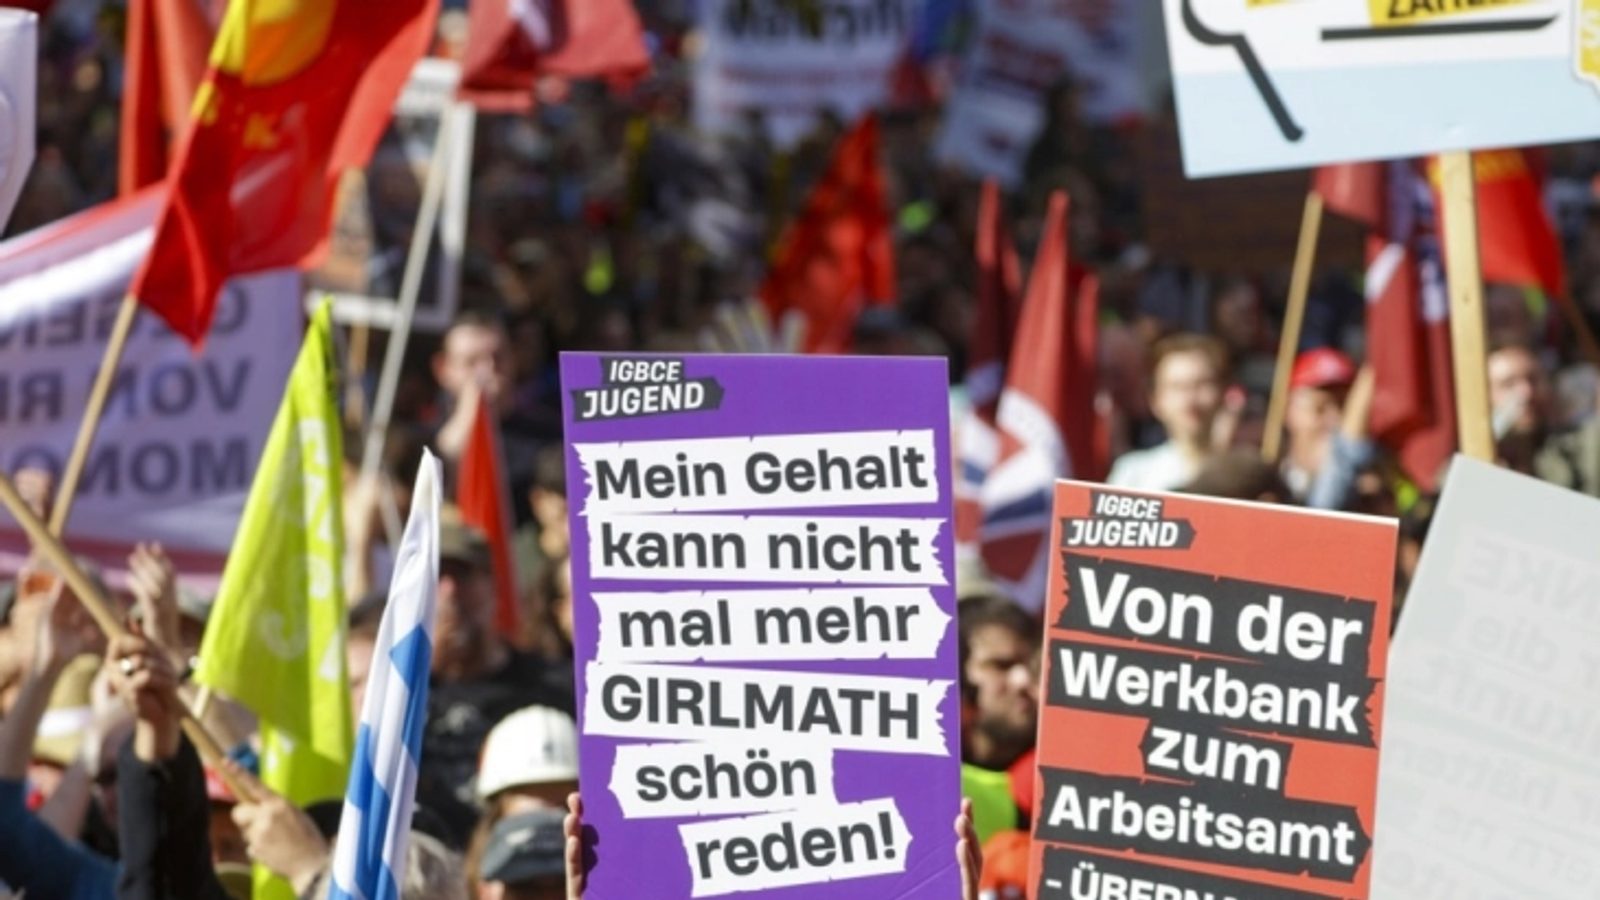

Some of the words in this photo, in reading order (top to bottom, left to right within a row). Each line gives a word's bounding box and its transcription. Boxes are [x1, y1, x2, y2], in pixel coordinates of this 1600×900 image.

[609, 360, 681, 383] IGBCE
[582, 382, 705, 419] JUGEND
[595, 452, 727, 501] Mein
[745, 446, 928, 494] Gehalt
[1067, 519, 1179, 548] JUGEND
[1095, 494, 1162, 520] IGBCE
[601, 522, 746, 569] kann
[768, 522, 922, 573] nicht
[619, 599, 732, 648] mal
[755, 596, 920, 644] mehr
[1079, 567, 1214, 644] Von
[1237, 594, 1363, 665] der
[601, 673, 919, 740] GIRLMATH
[1059, 648, 1360, 734] Werkbank
[635, 748, 817, 803] schön
[1147, 726, 1282, 789] zum
[696, 811, 897, 880] reden!
[1047, 785, 1356, 866] Arbeitsamt
